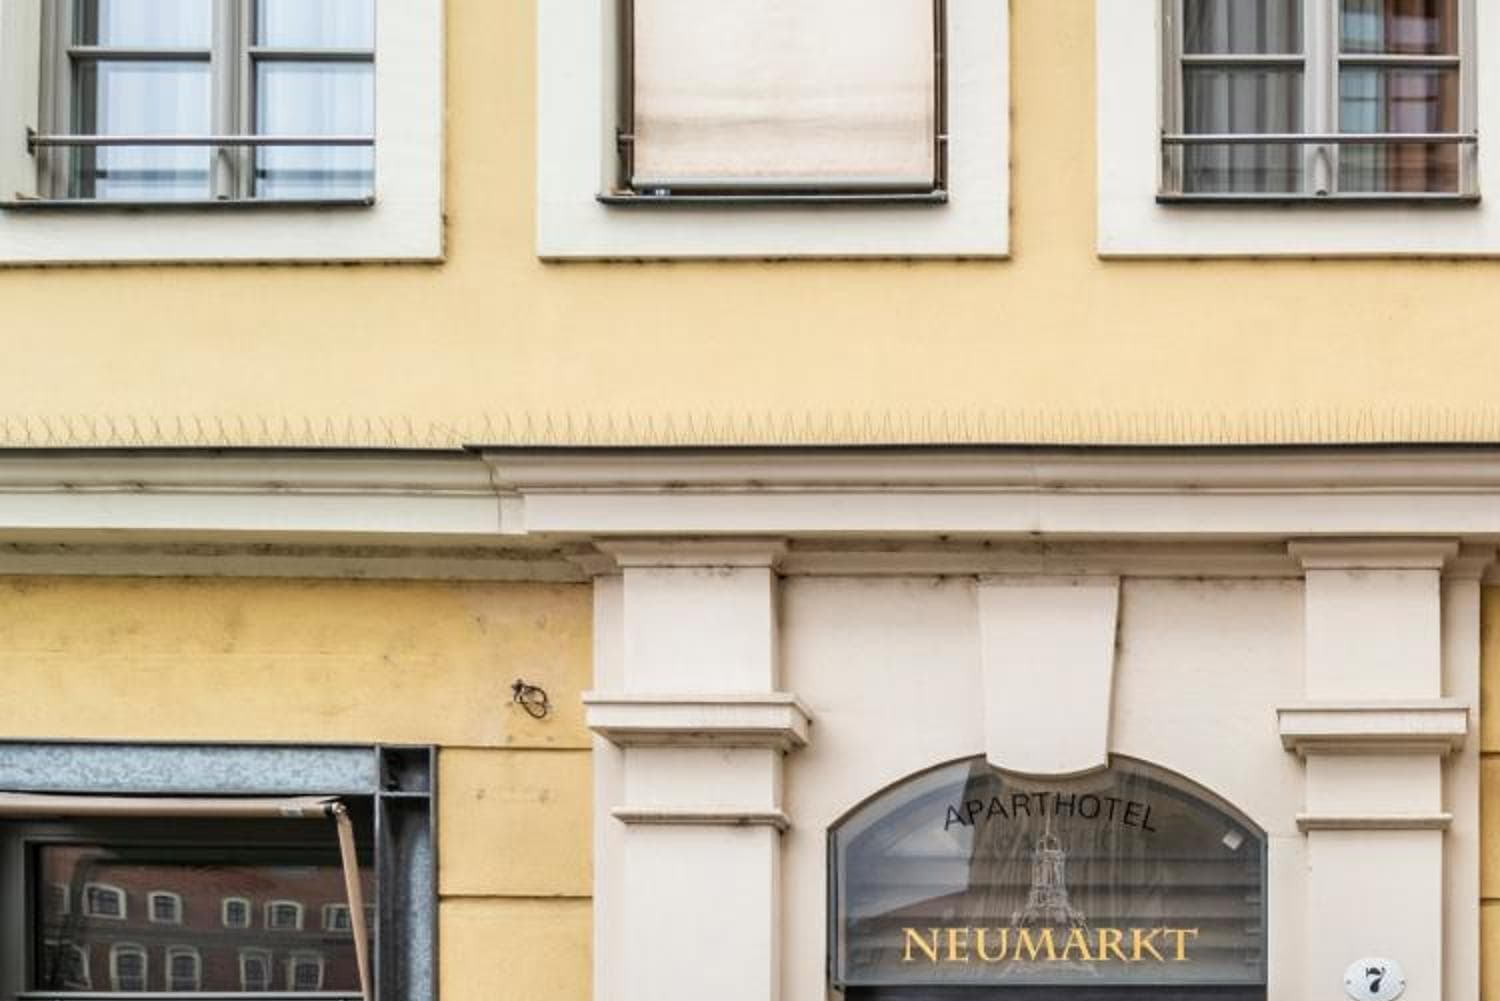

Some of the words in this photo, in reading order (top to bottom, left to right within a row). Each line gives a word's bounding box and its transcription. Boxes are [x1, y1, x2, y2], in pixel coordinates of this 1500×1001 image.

[944, 791, 1156, 832] APARTHOTEL
[902, 926, 1199, 962] NEUMARKT
[1365, 966, 1386, 994] 7
